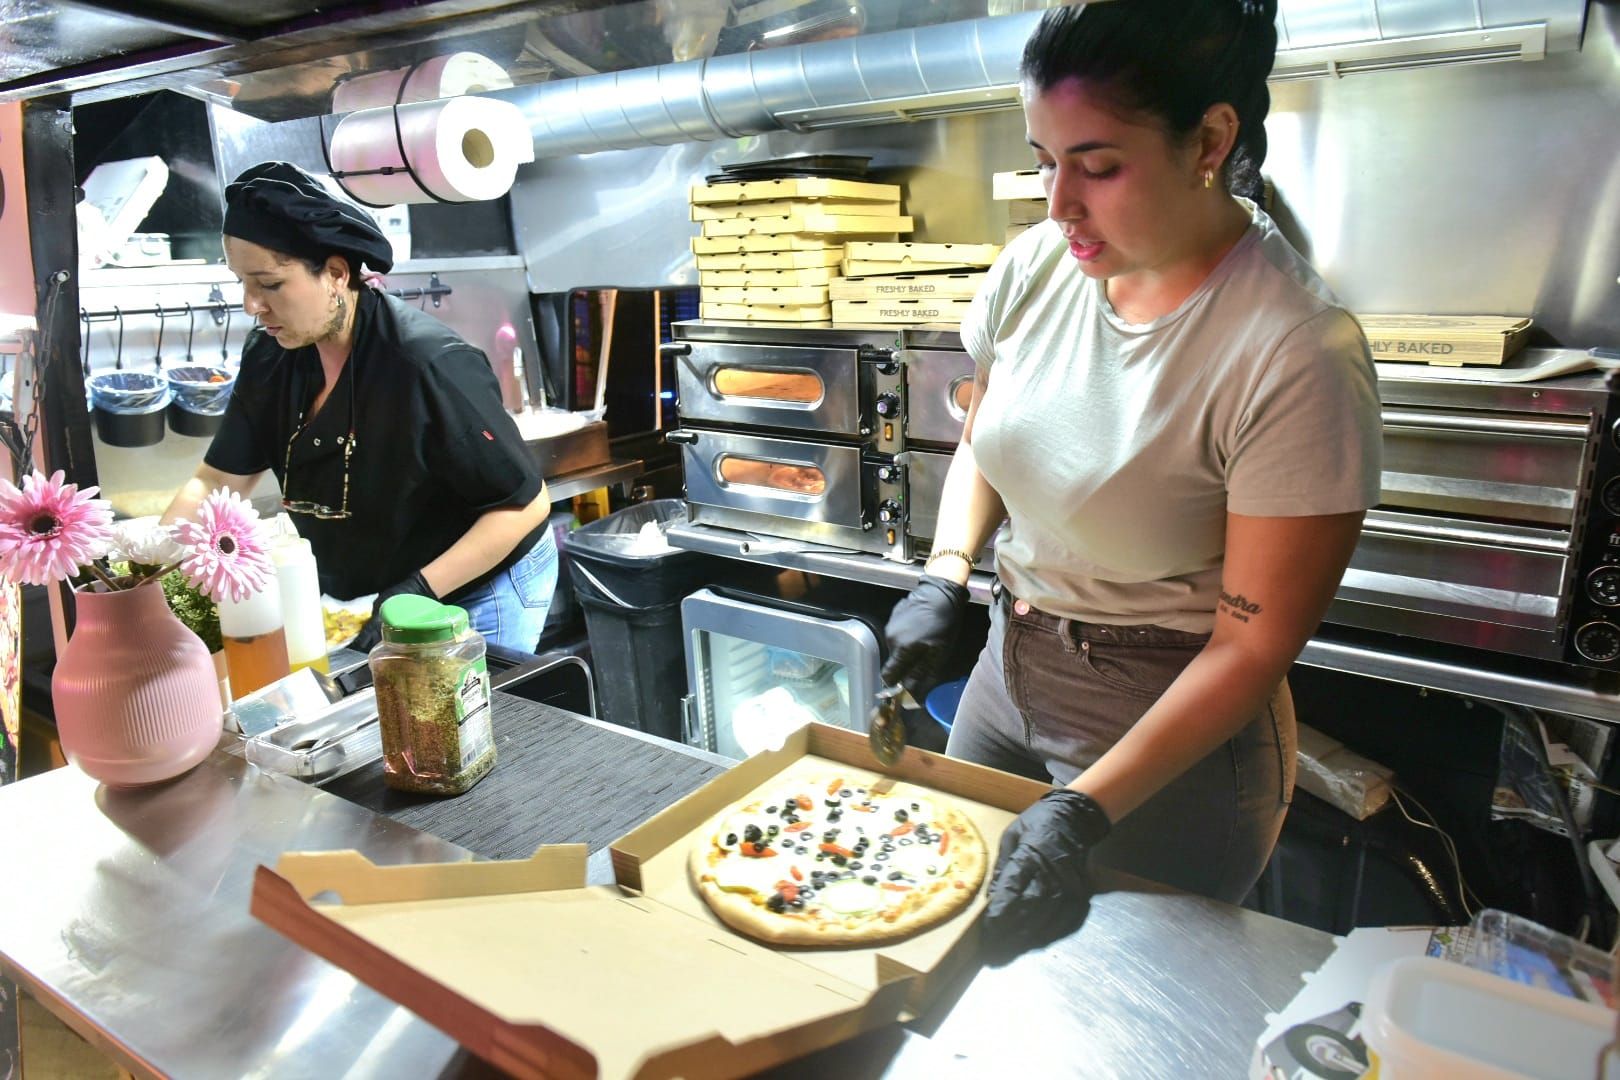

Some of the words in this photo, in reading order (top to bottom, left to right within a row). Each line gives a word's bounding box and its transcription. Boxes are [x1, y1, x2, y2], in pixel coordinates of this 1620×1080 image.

[876, 285, 906, 293] FRESHLY
[908, 285, 935, 293] BAKED
[879, 309, 910, 317] FRESHLY
[912, 309, 939, 317] BAKED
[1397, 342, 1453, 354] BAKED
